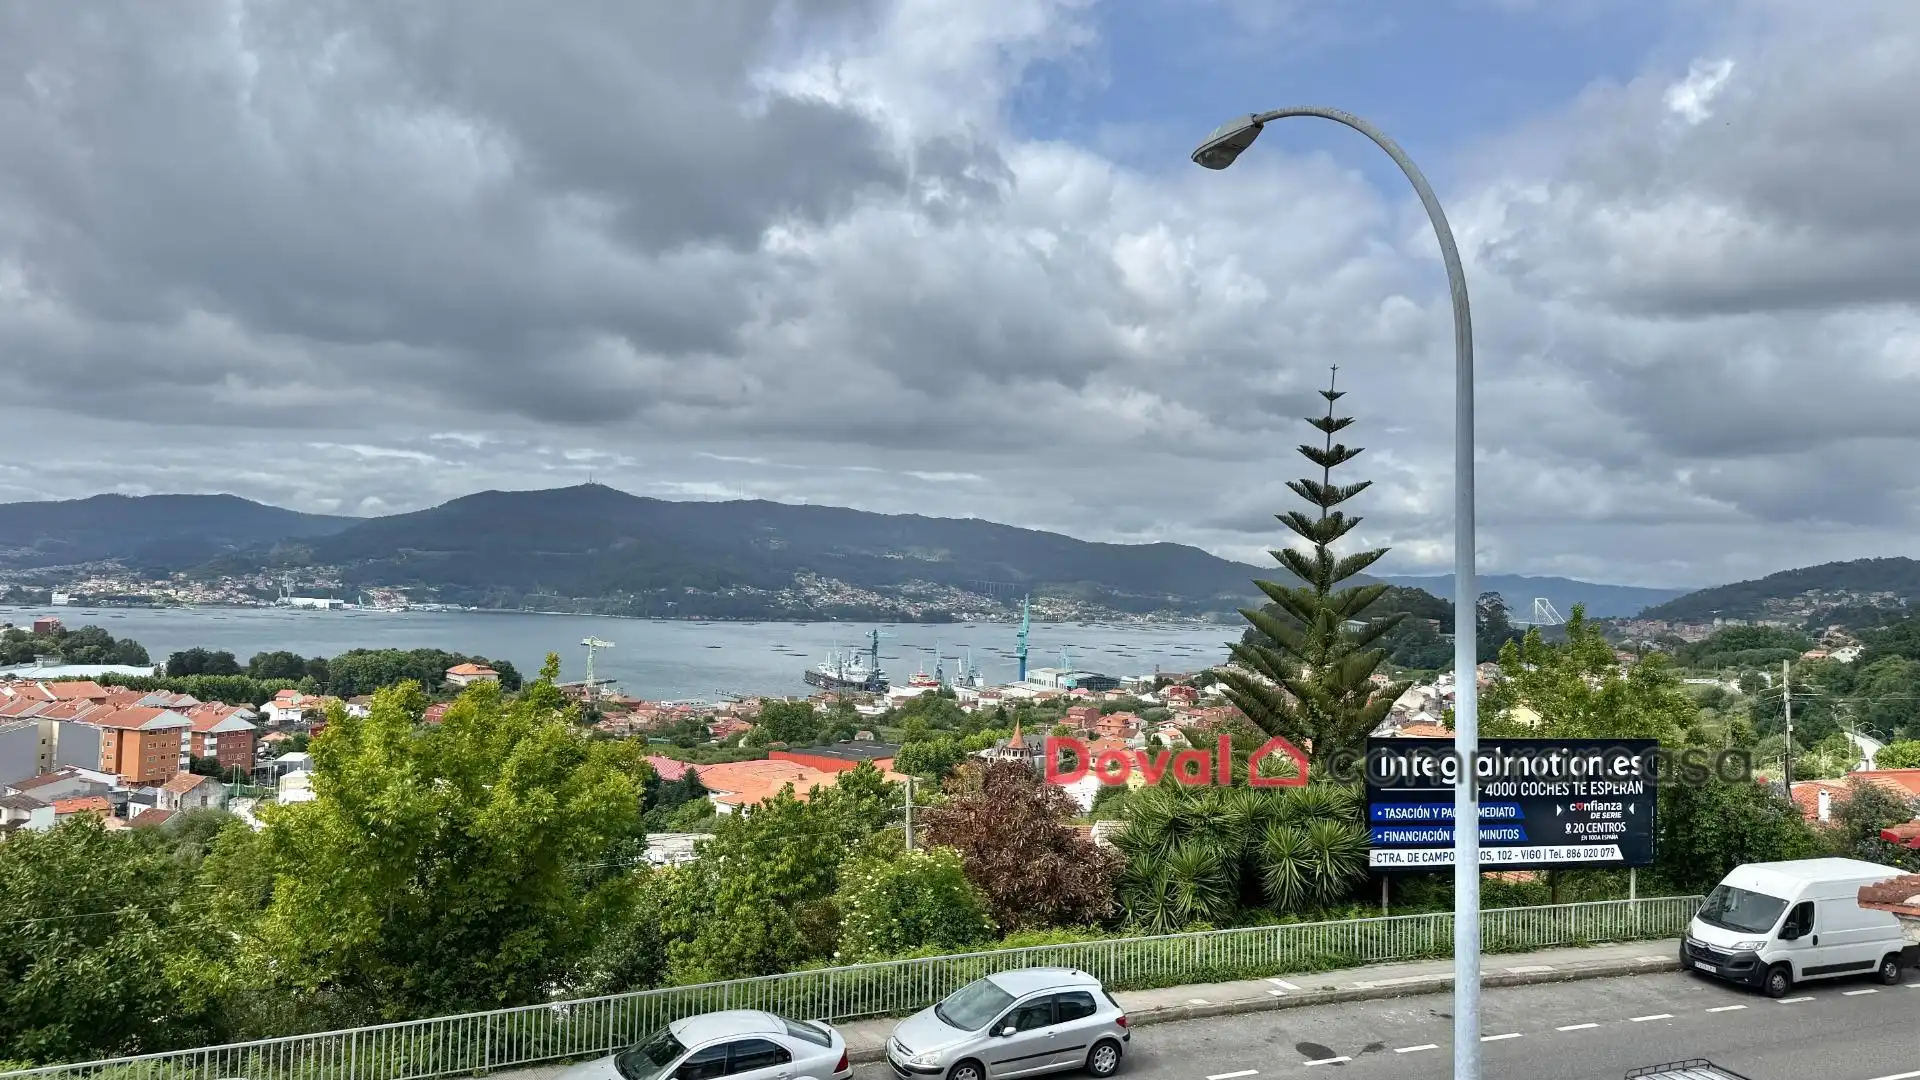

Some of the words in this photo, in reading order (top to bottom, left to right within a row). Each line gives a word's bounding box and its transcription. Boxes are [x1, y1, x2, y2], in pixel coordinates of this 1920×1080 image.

[1380, 747, 1641, 784] integalmotion.es
[1484, 782, 1517, 797] 4000
[1520, 782, 1570, 796] COCHES
[1573, 782, 1588, 796] TE
[1590, 780, 1644, 796] ESPERAN
[1384, 805, 1430, 819] TASACIÓN
[1432, 807, 1439, 818] Y
[1601, 811, 1623, 819] SERIE
[1573, 822, 1585, 834] 20
[1586, 821, 1627, 833] CENTROS
[1383, 828, 1450, 842] FINANCIACIÓN
[1479, 829, 1520, 840] MINUTOS
[1376, 853, 1405, 863] CTRA.
[1407, 852, 1420, 863] DE
[1497, 850, 1513, 860] 102
[1520, 850, 1541, 860] VIGO
[1549, 850, 1564, 859] Tel.
[1566, 849, 1581, 858] 886
[1583, 848, 1598, 858] 020
[1600, 848, 1615, 858] 079
